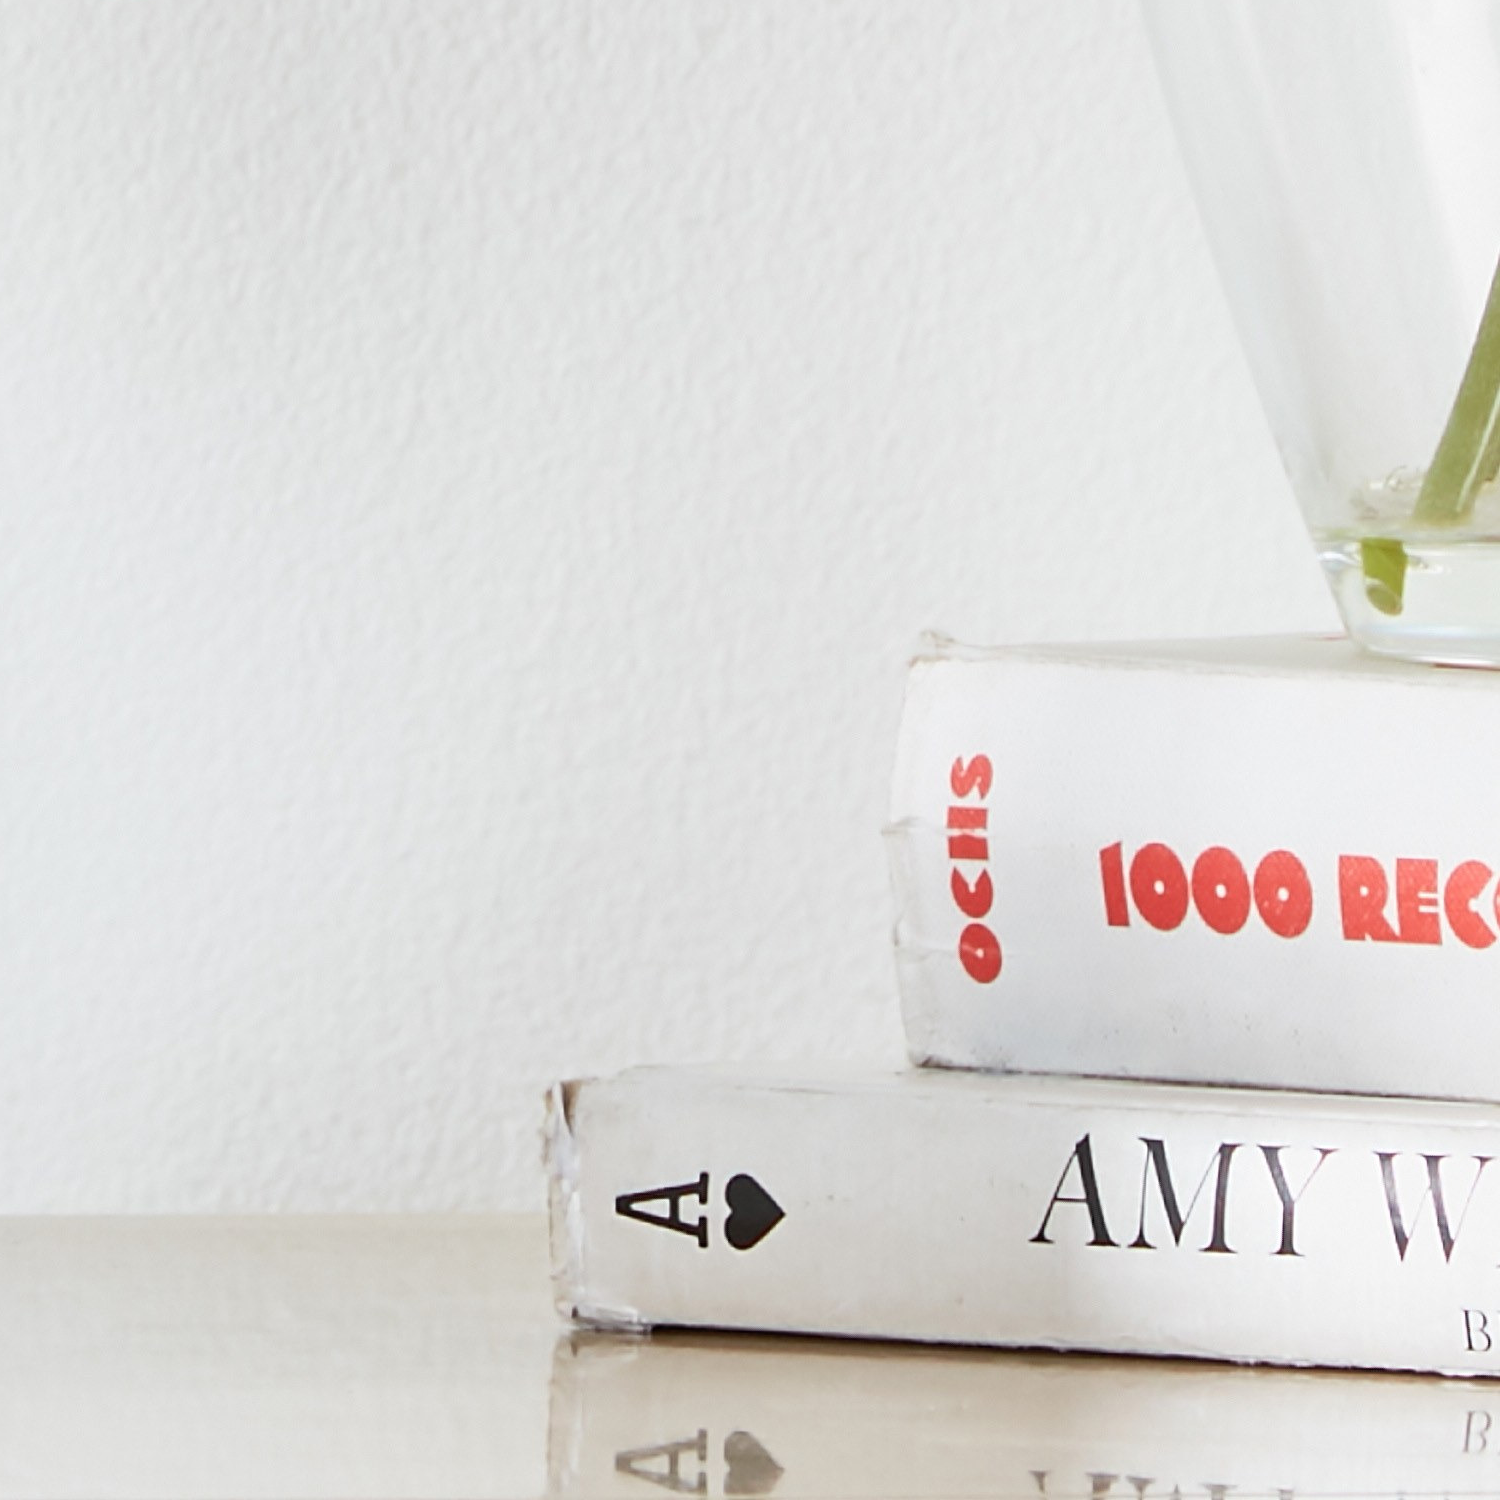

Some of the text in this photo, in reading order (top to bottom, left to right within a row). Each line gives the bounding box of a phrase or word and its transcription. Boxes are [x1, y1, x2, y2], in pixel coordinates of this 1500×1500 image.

[1099, 841, 1500, 949] 1000 REC
[614, 1171, 709, 1249] A
[1028, 1133, 1500, 1268] AMY W
